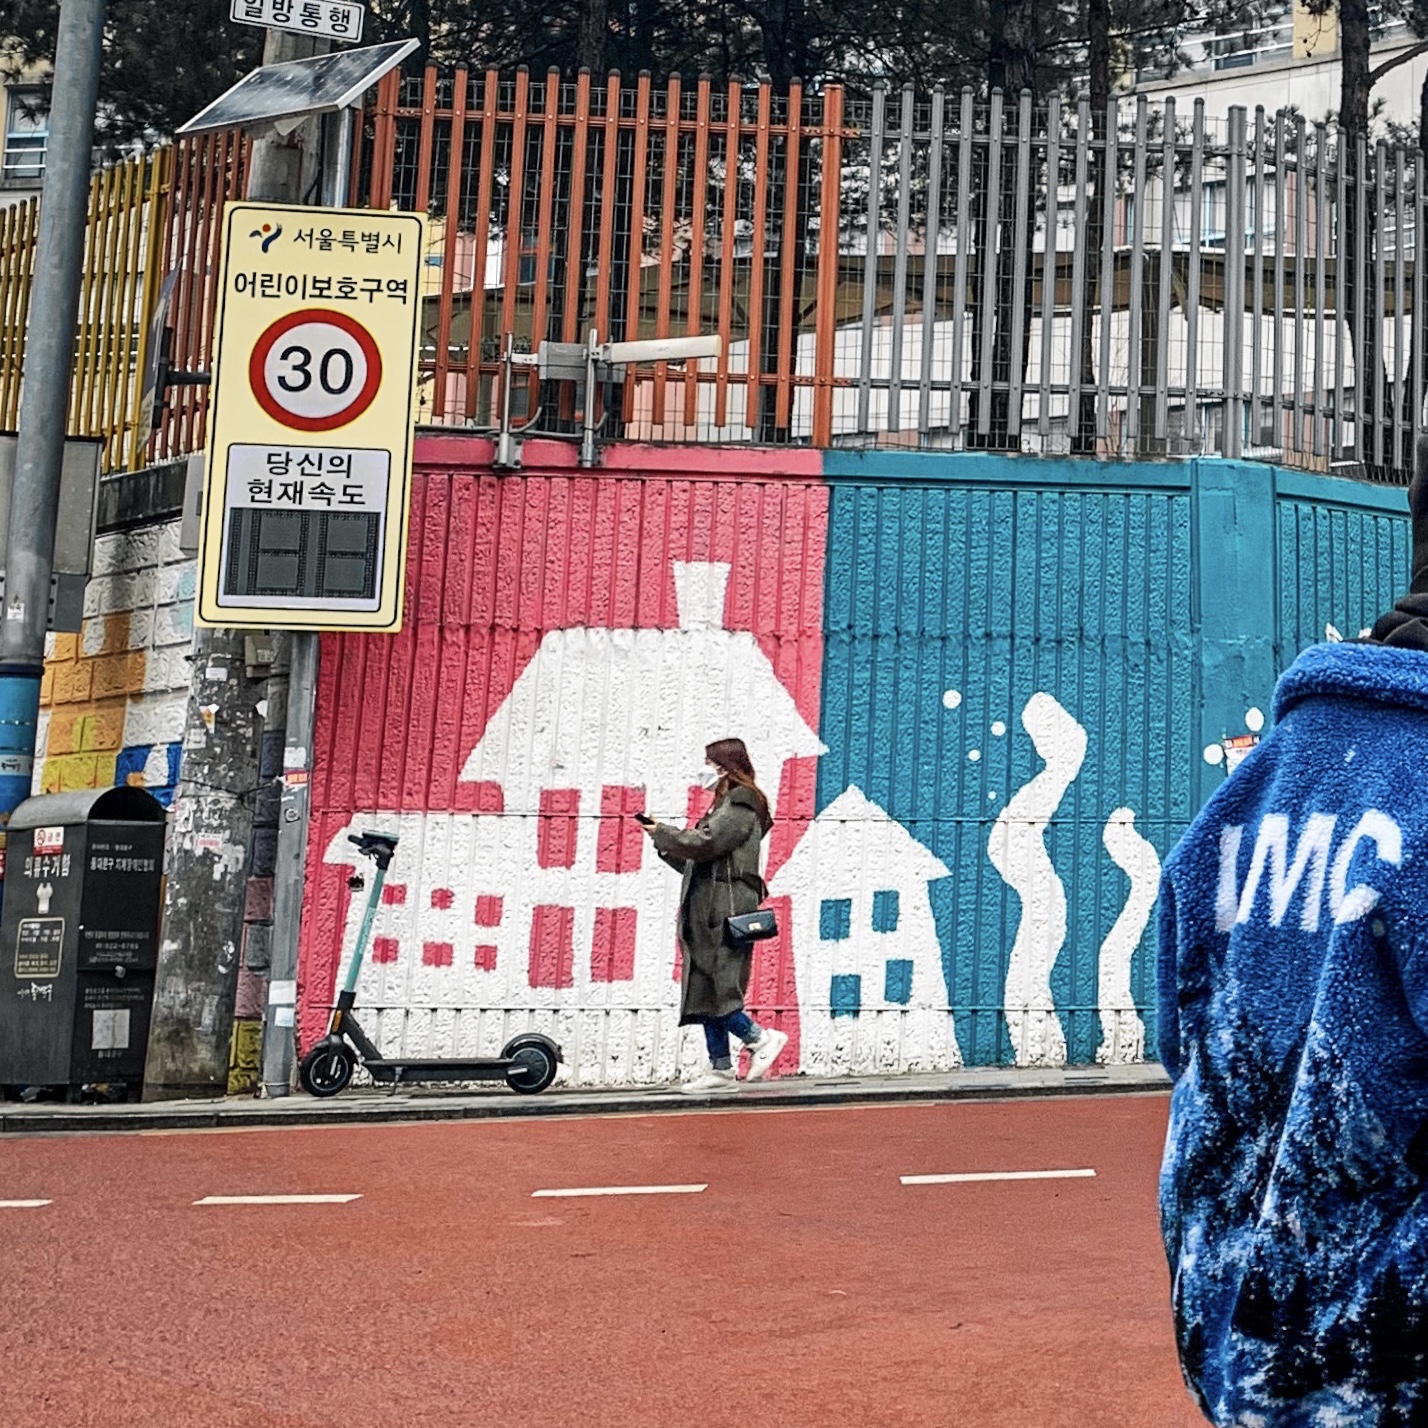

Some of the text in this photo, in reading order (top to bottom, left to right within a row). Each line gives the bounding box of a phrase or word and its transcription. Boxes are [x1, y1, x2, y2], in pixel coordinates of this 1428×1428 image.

[244, 0, 351, 33] 일방통행
[293, 227, 402, 254] 서울특별시
[234, 271, 409, 305] 어린이보호구역
[277, 345, 353, 395] 30
[266, 451, 352, 479] 당신의
[247, 479, 366, 507] 현재속도
